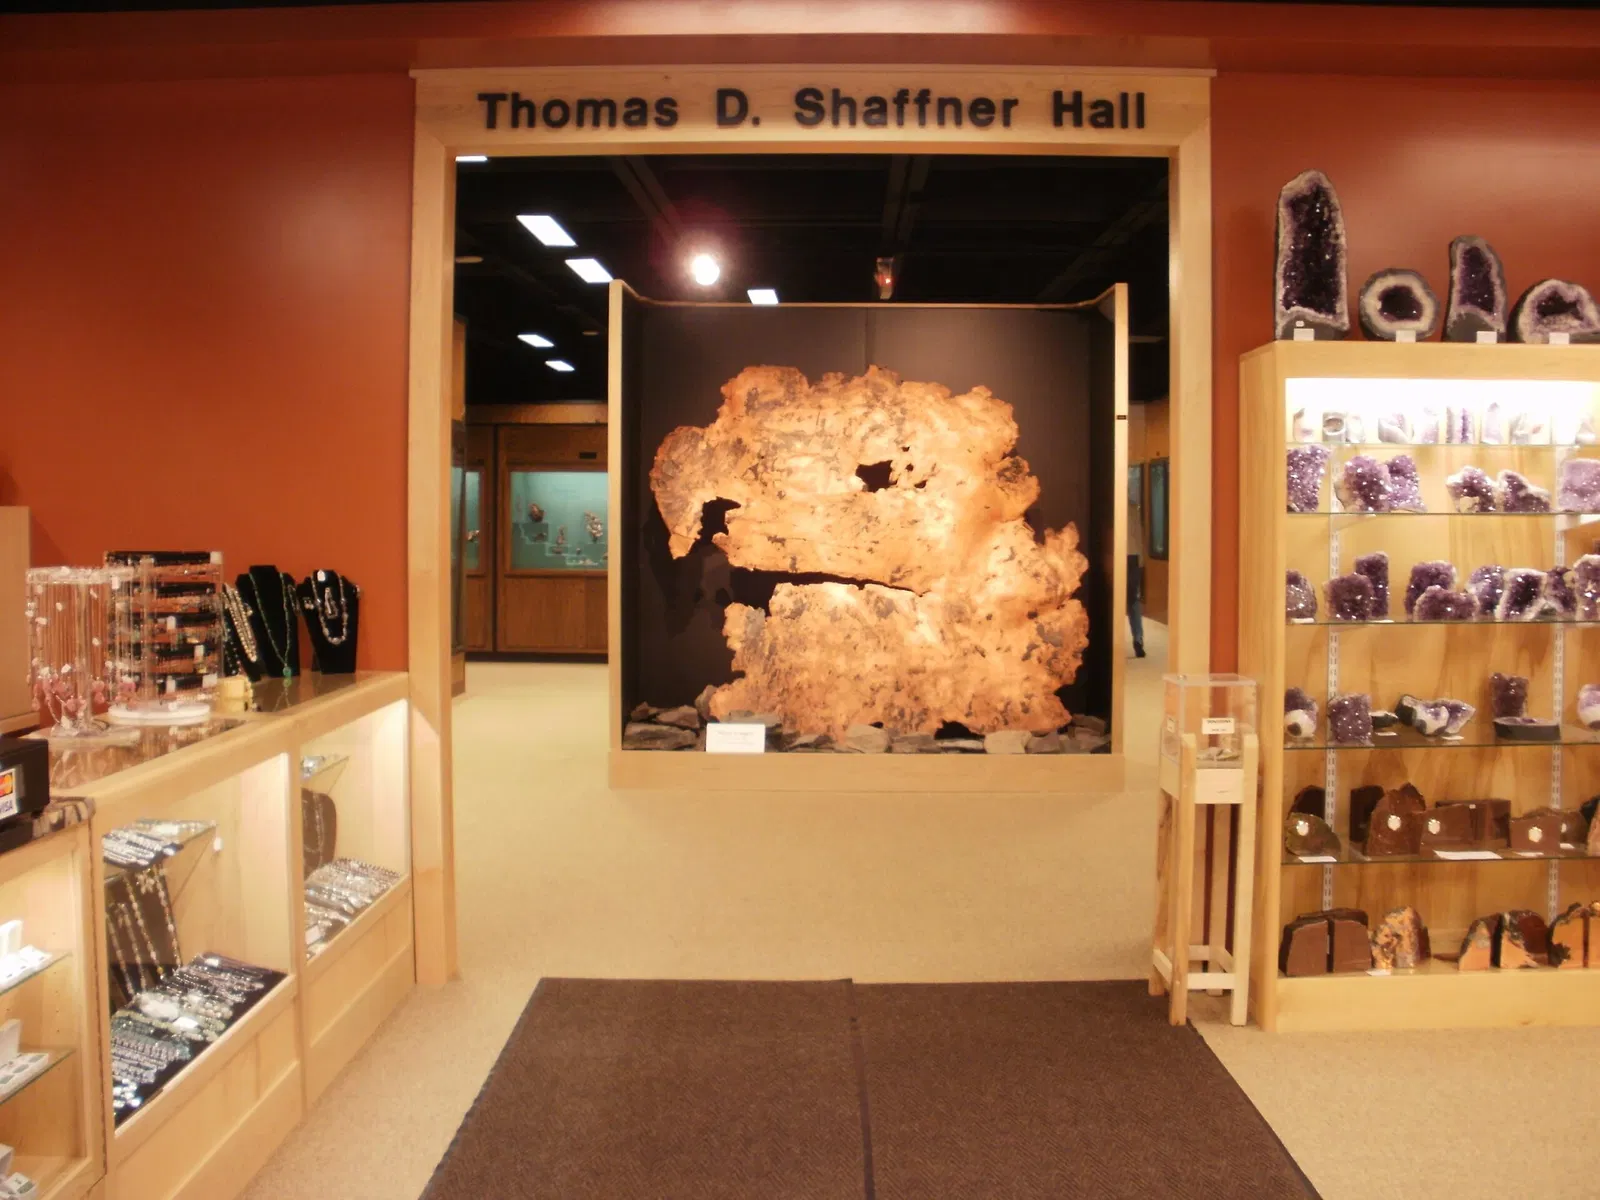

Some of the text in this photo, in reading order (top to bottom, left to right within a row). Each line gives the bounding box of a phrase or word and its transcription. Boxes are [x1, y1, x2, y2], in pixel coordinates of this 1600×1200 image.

[476, 87, 1146, 130] Thomas D. Shaffner Hall
